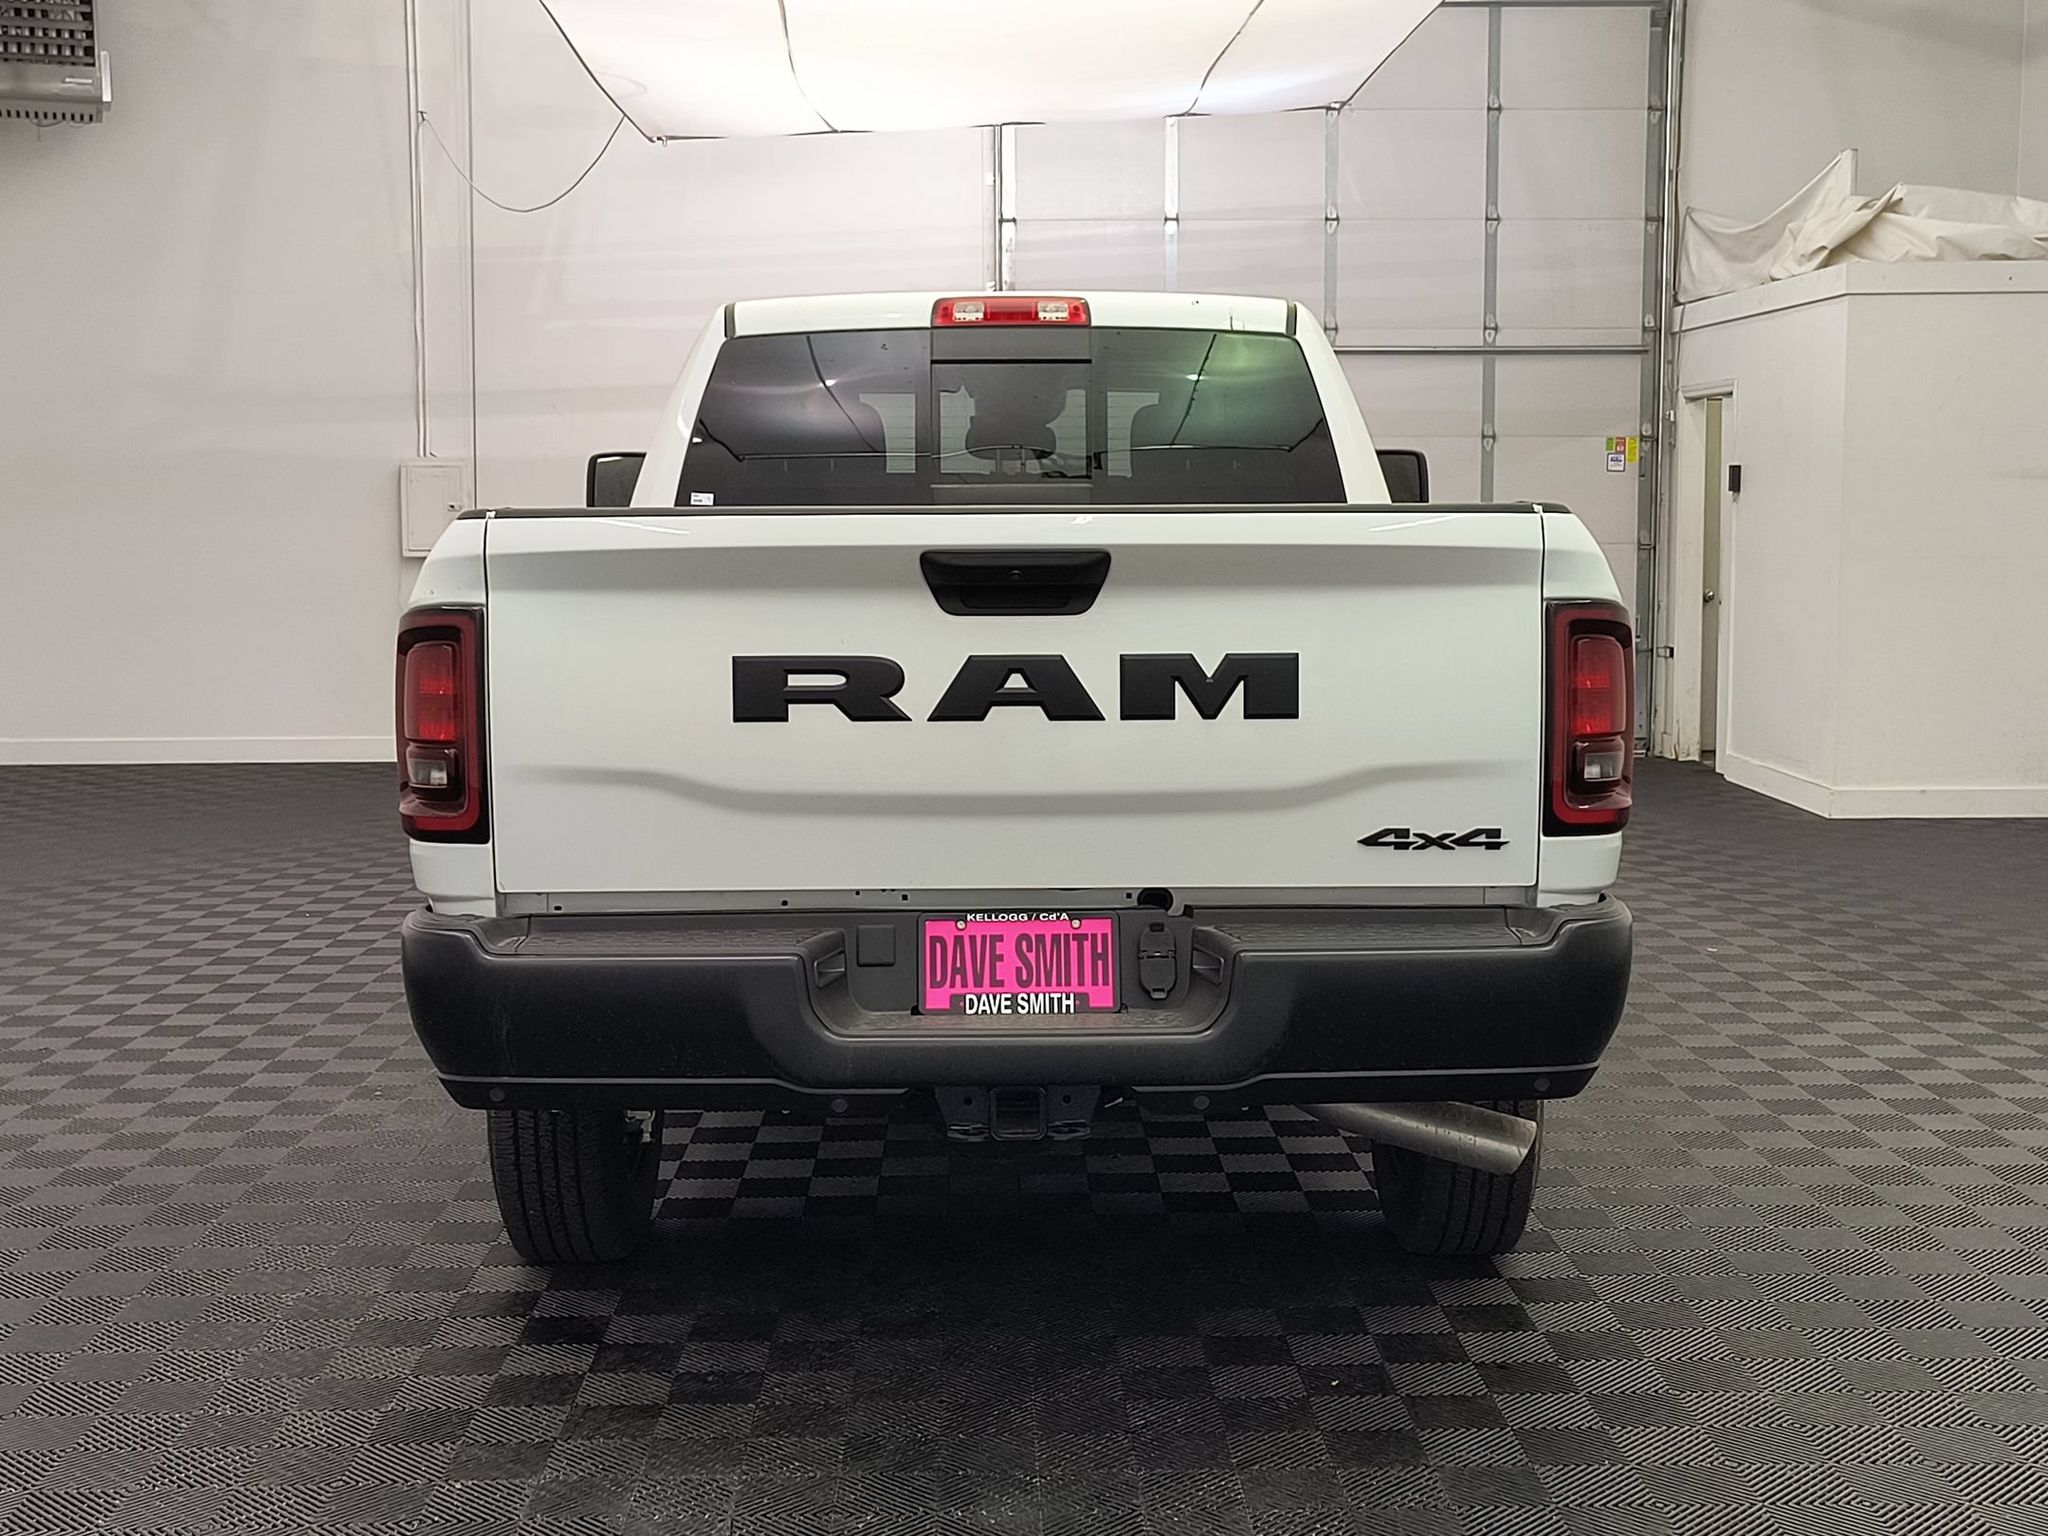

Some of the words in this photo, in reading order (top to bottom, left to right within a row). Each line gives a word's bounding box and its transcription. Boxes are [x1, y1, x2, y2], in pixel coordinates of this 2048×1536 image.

[732, 652, 1300, 723] RAM
[1357, 827, 1510, 850] 4x4
[966, 912, 1028, 922] KELLOGG
[929, 934, 1004, 989] DAVE
[1015, 932, 1110, 988] SMITH
[965, 993, 1012, 1015] DAVE
[1017, 992, 1075, 1014] SMITH
